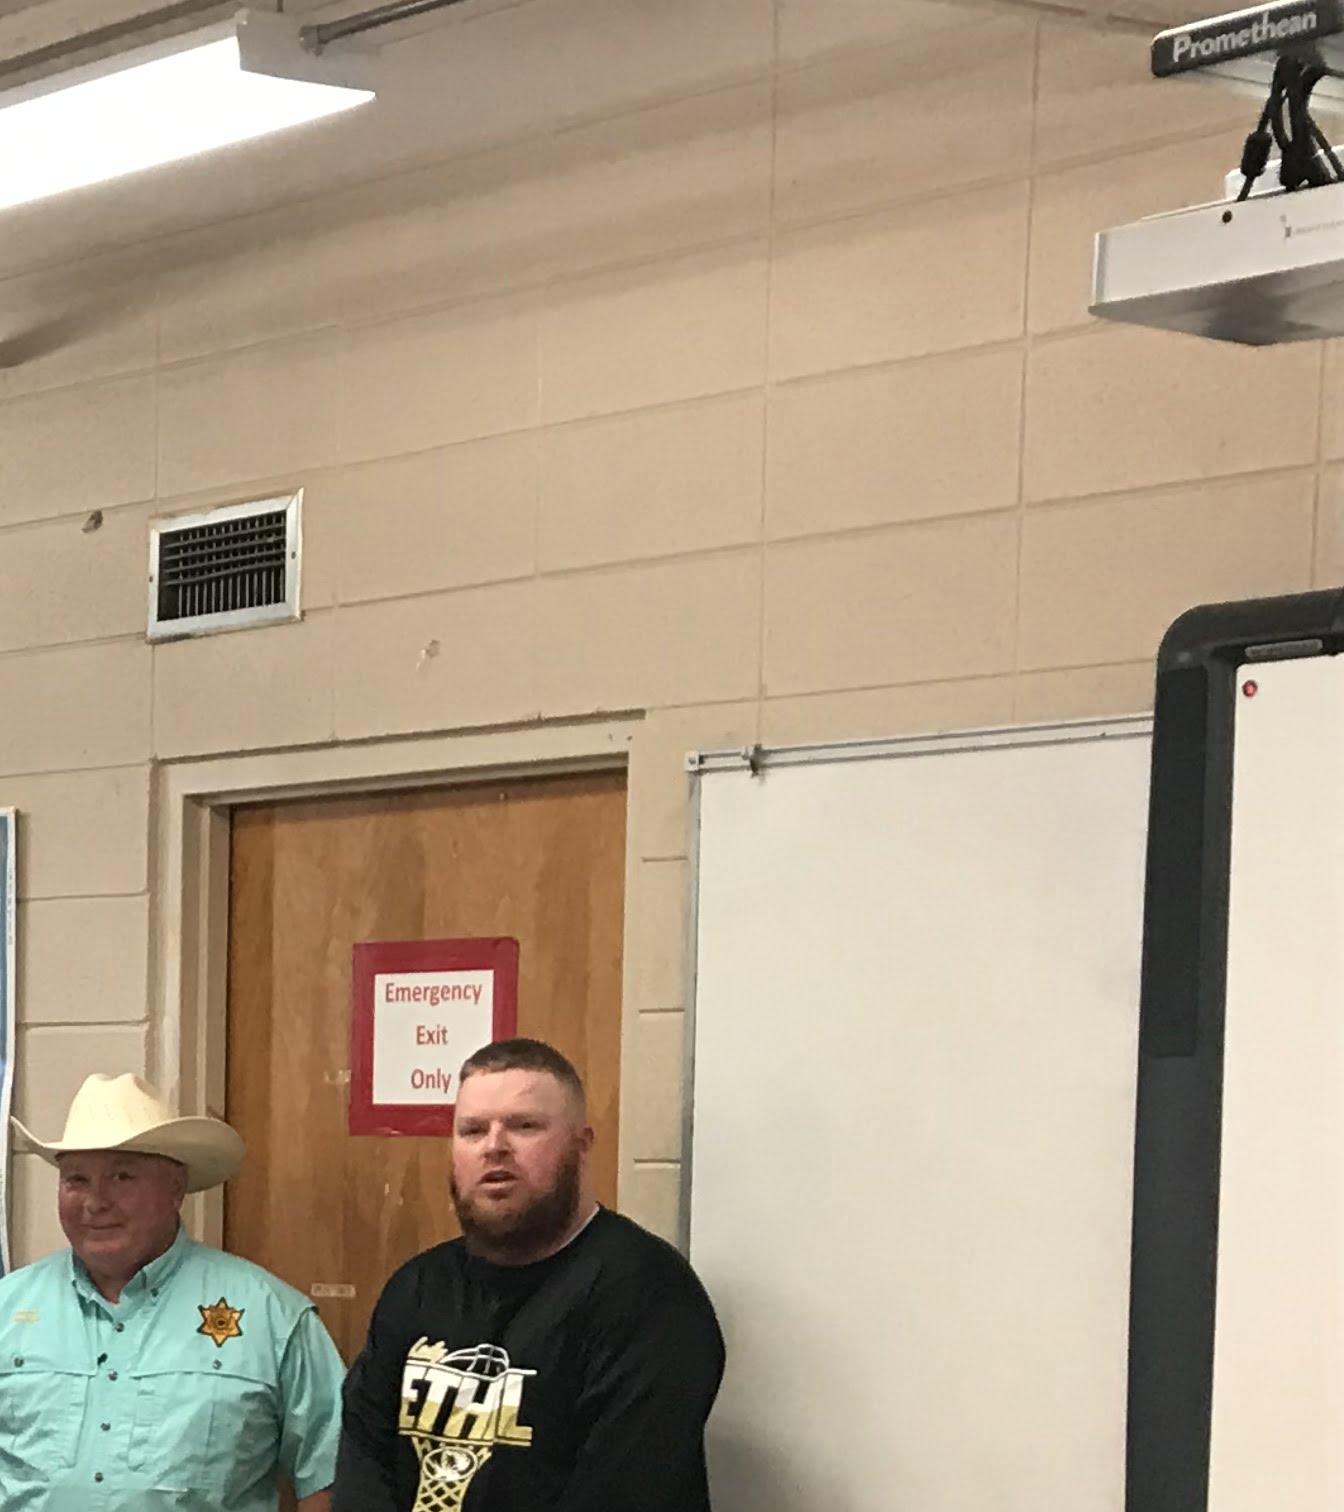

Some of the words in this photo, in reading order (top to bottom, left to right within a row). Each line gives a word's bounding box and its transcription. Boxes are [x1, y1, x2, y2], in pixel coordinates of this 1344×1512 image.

[1173, 11, 1317, 63] Promethean
[384, 982, 483, 1006] Emergency
[415, 1024, 448, 1046] Exit
[411, 1067, 452, 1094] Only
